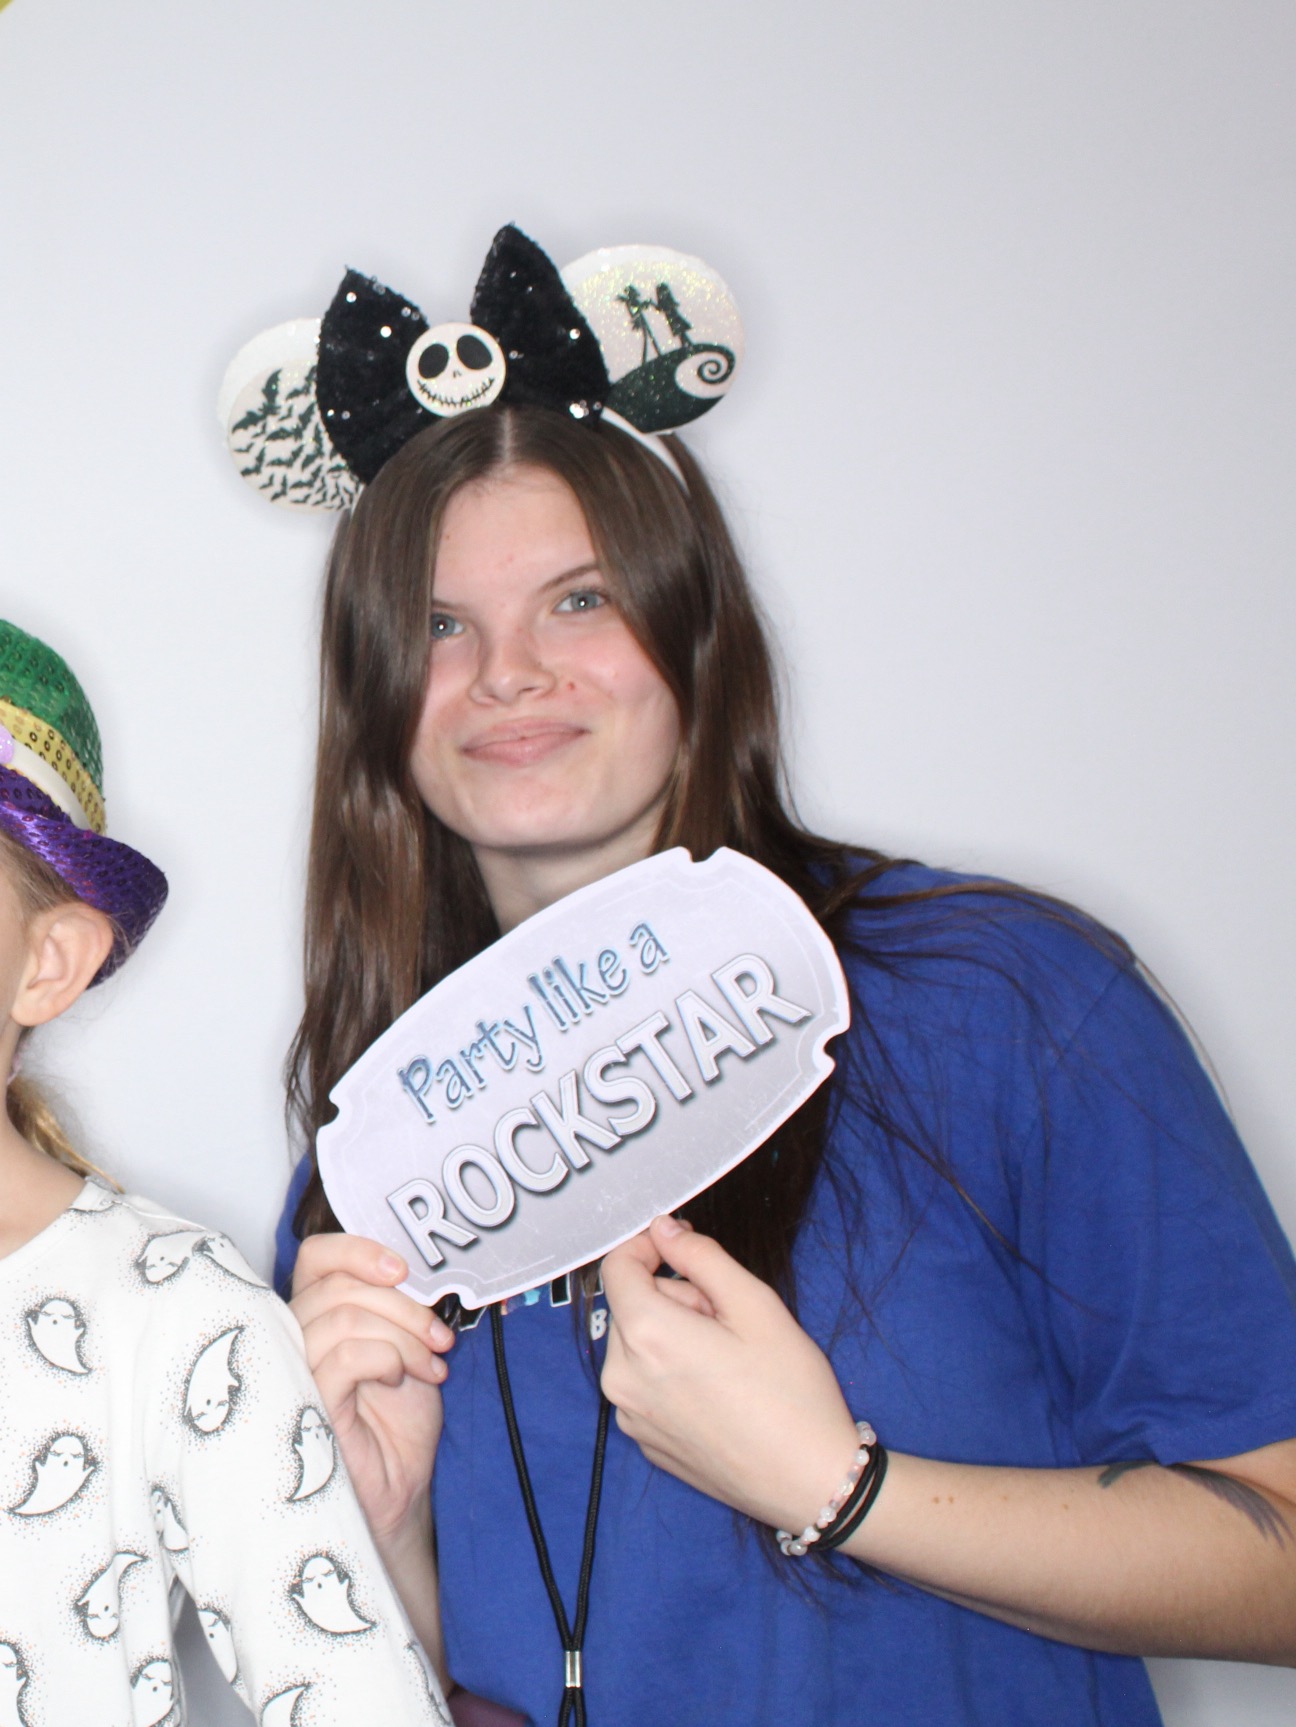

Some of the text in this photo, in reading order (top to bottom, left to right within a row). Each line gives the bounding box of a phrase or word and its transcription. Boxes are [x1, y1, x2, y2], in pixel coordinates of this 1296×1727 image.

[386, 952, 813, 1269] ROCKSTAR
[397, 920, 670, 1124] Party like a
